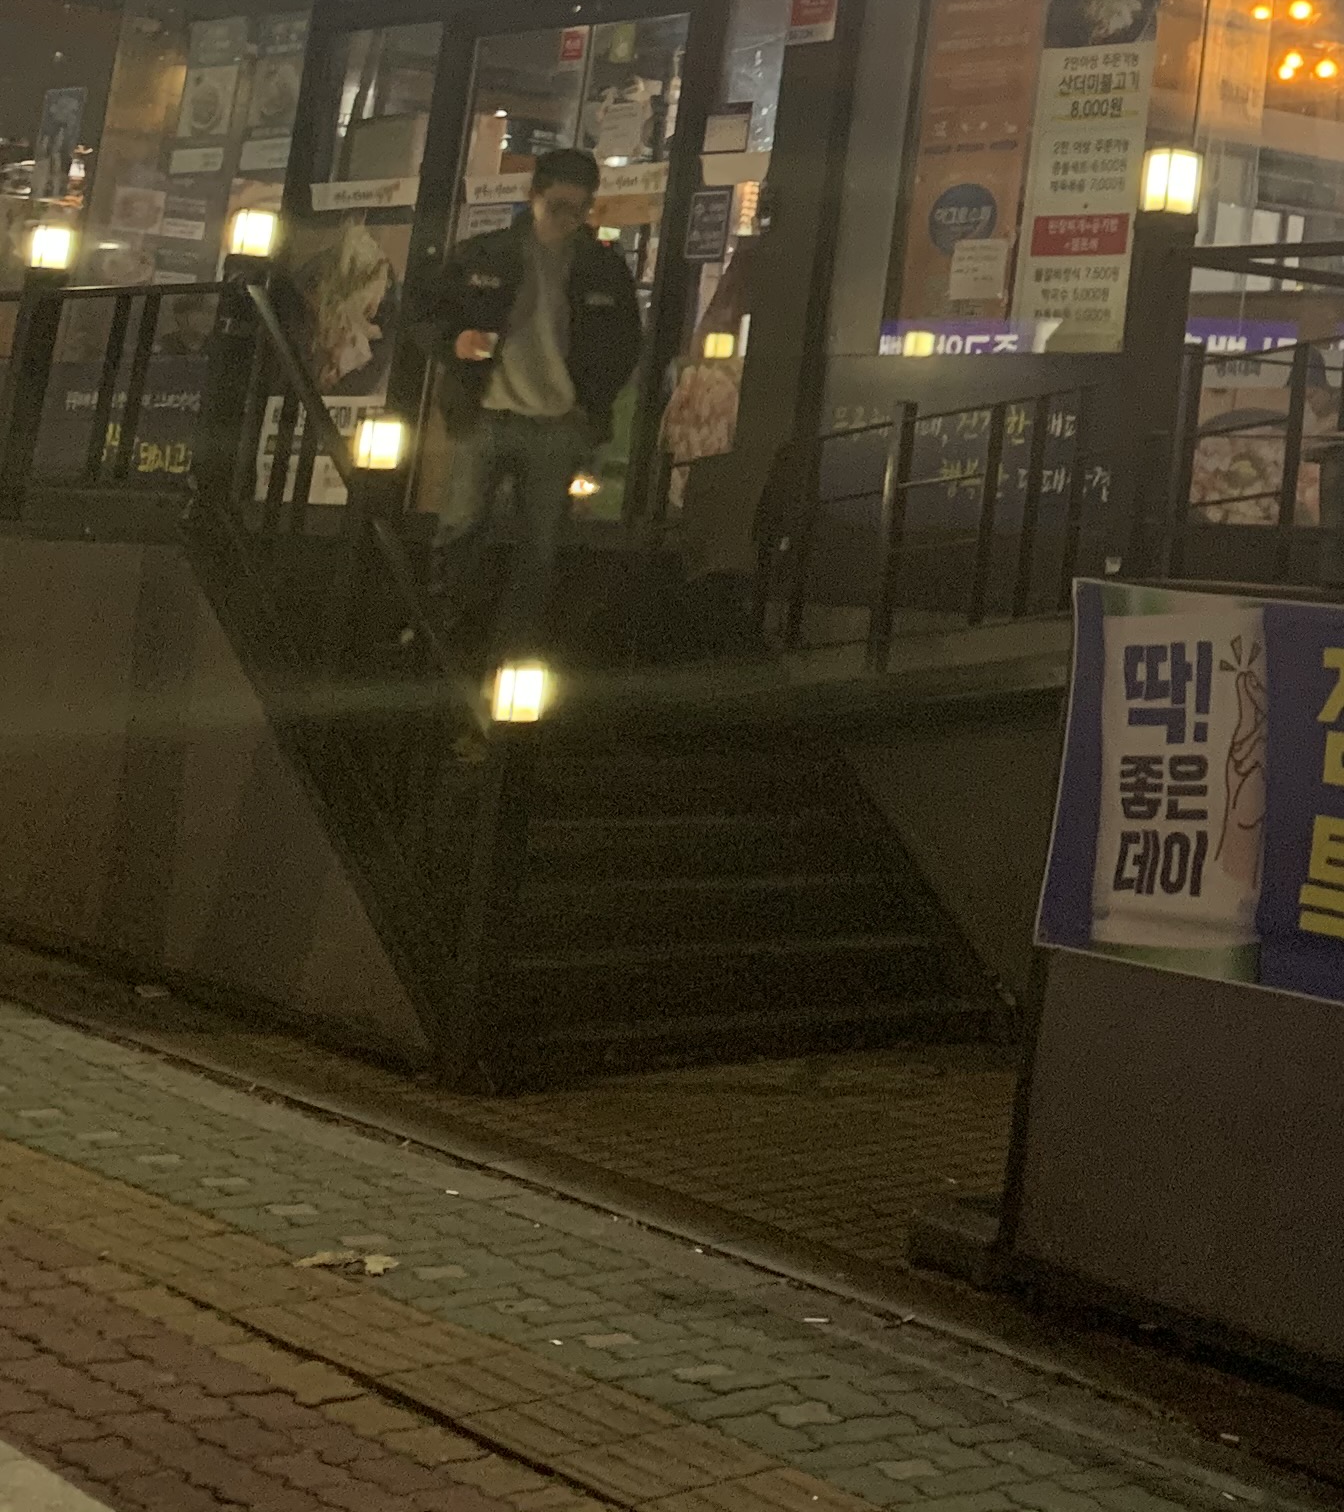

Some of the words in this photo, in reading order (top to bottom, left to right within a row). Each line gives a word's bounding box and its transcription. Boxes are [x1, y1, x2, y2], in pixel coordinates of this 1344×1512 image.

[1123, 642, 1213, 744] 딱!
[1120, 754, 1209, 821] 좋은
[1112, 829, 1209, 897] 데이
